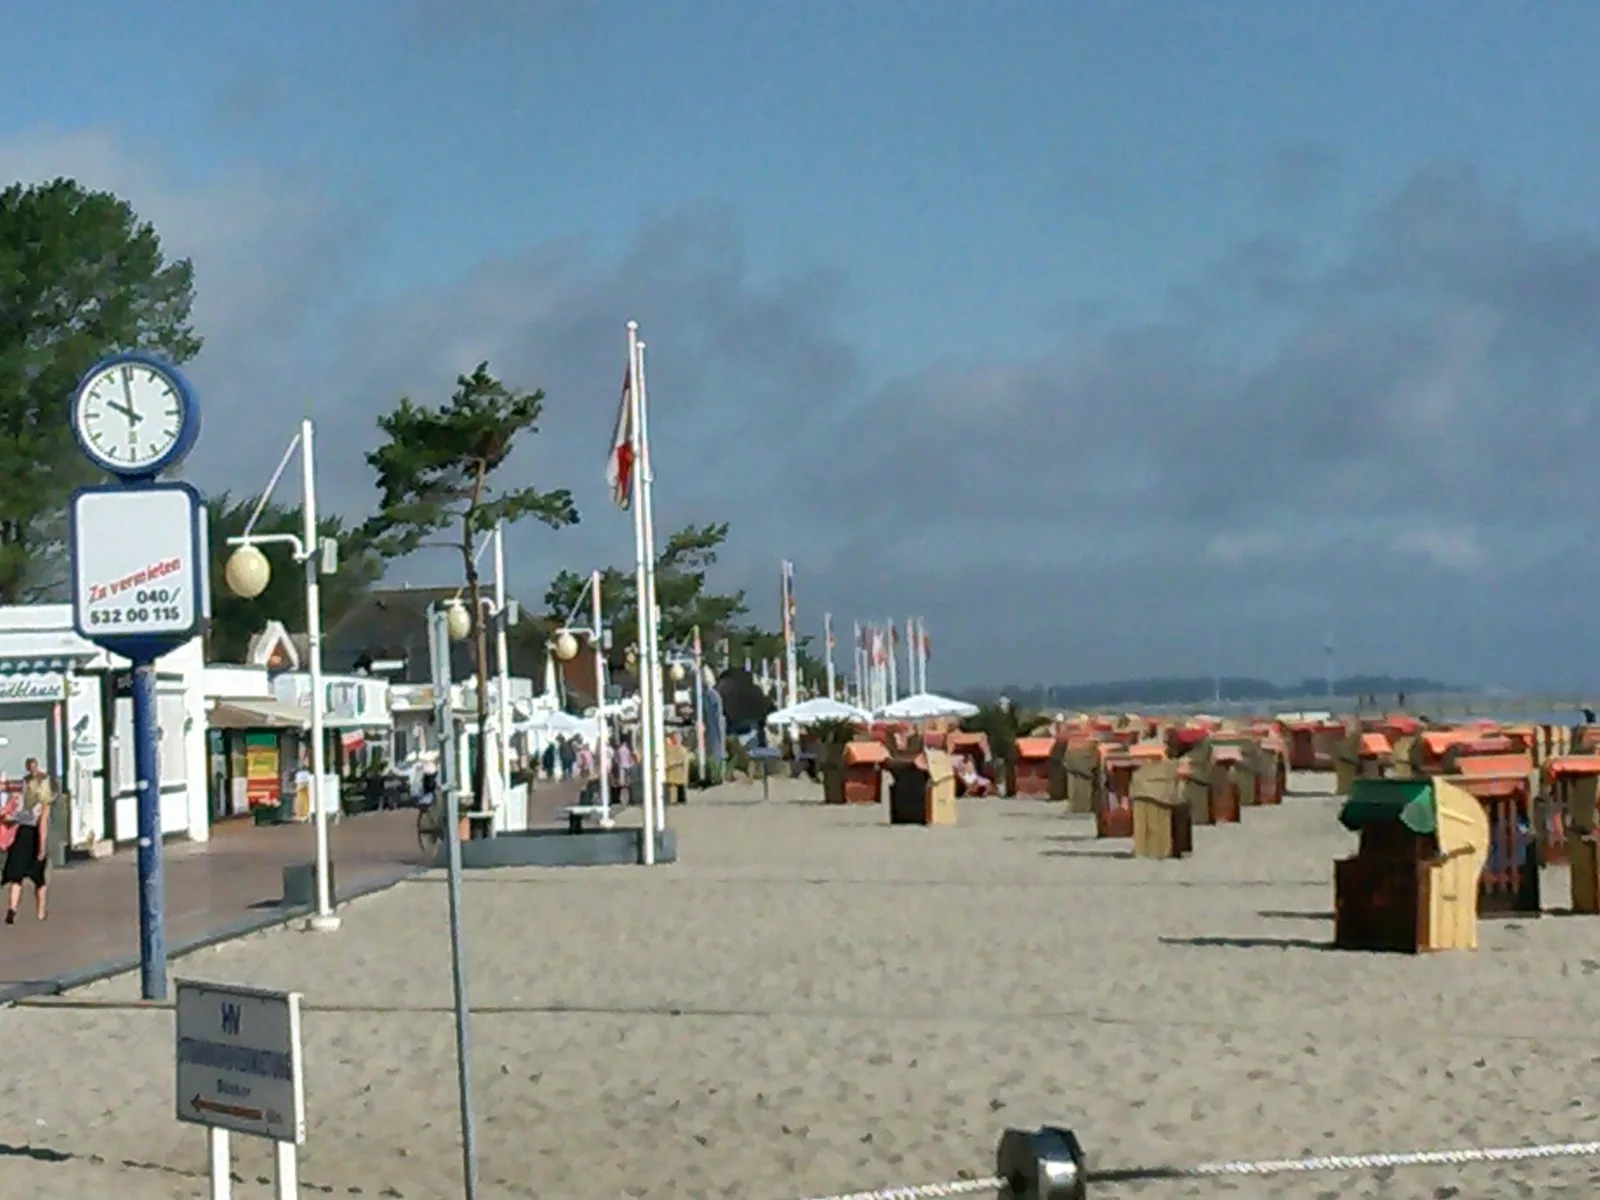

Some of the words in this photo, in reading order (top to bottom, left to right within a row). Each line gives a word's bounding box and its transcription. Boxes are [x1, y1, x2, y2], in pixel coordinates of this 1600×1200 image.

[109, 557, 182, 595] vermieten
[136, 587, 181, 604] 040/
[90, 609, 122, 624] 532
[126, 607, 149, 622] 00
[153, 606, 180, 620] 115
